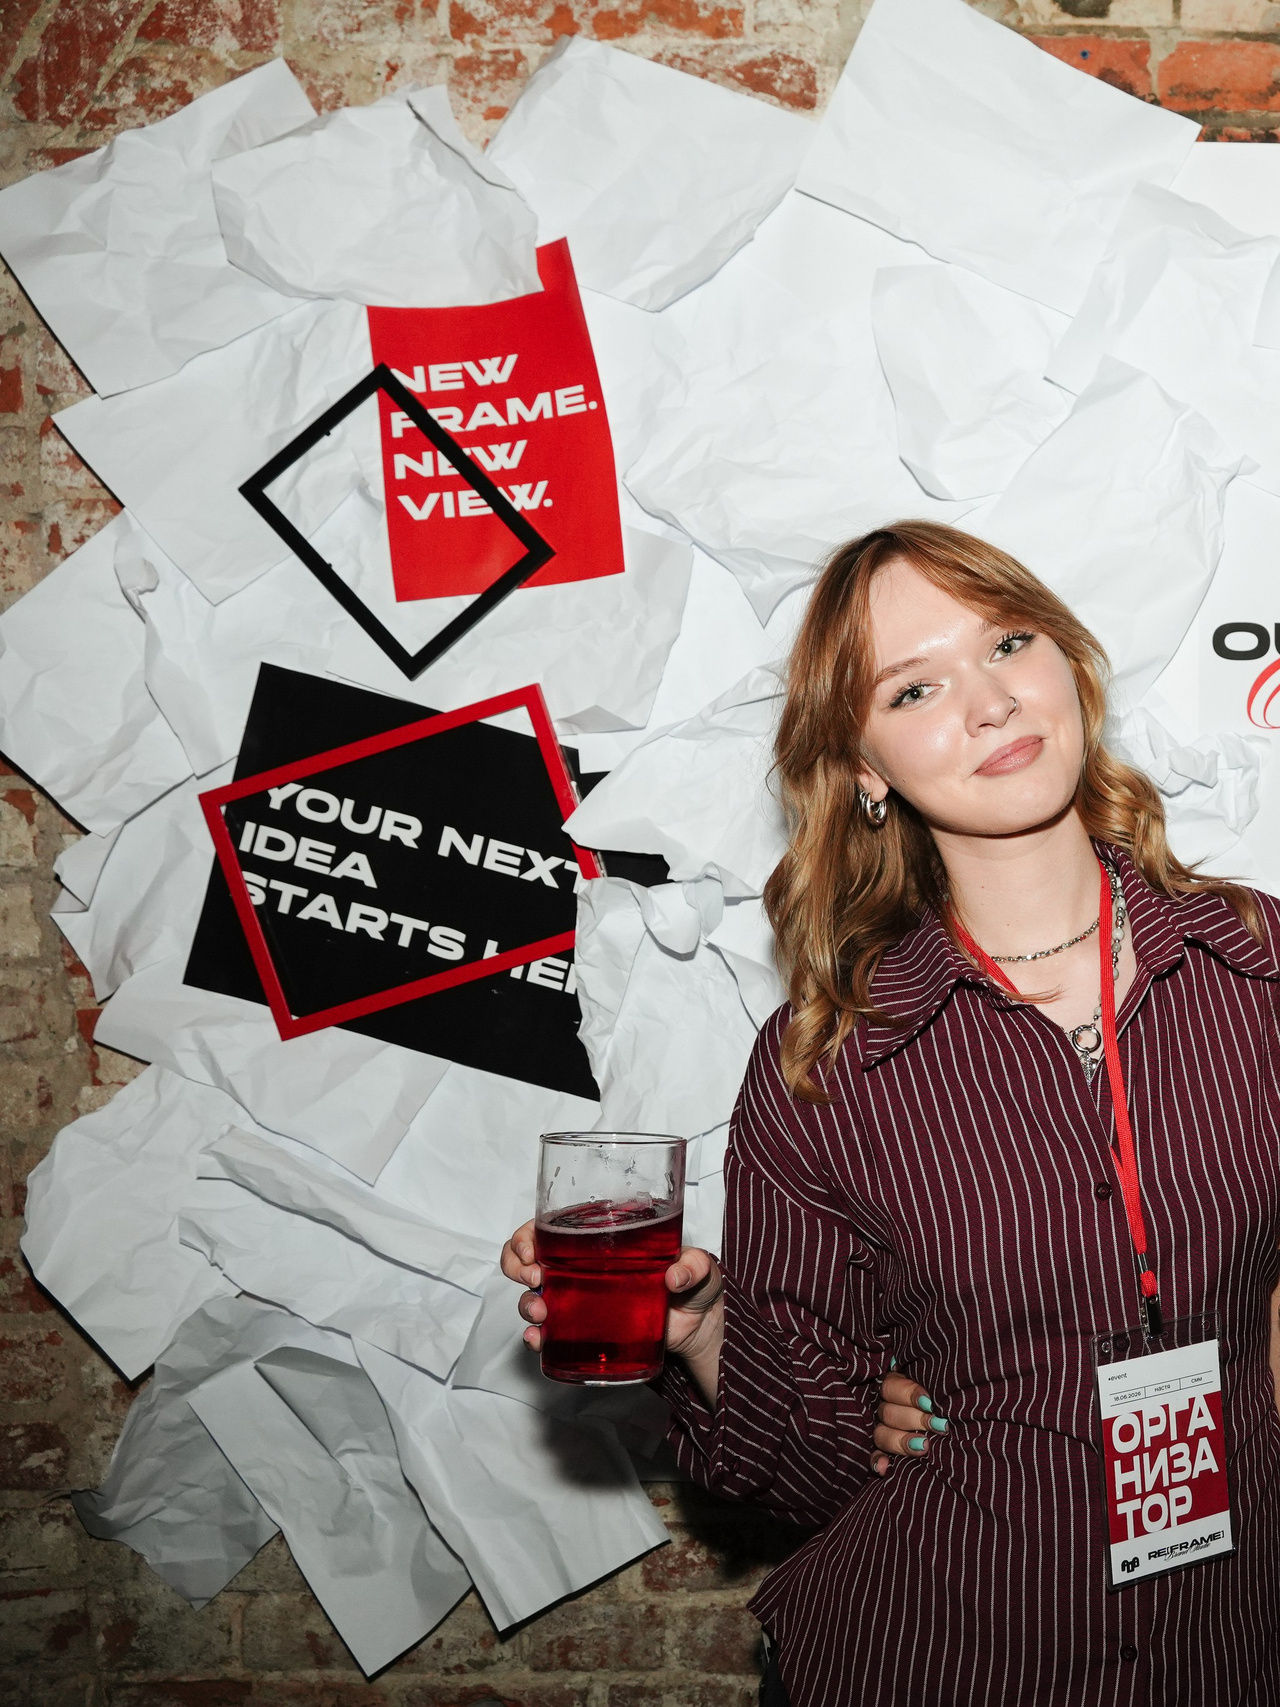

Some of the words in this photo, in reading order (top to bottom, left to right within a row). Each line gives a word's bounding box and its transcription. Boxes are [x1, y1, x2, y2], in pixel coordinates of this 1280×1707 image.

[390, 354, 518, 393] NEW
[390, 384, 598, 438] FRAME.
[397, 480, 553, 521] VIEW.
[267, 782, 423, 850] YOUR
[238, 820, 378, 889] IDEA
[241, 870, 467, 961] STARTS
[1111, 1395, 1216, 1454] ОРГА
[1113, 1436, 1220, 1501] НИЗА
[1116, 1485, 1193, 1541] ТОР
